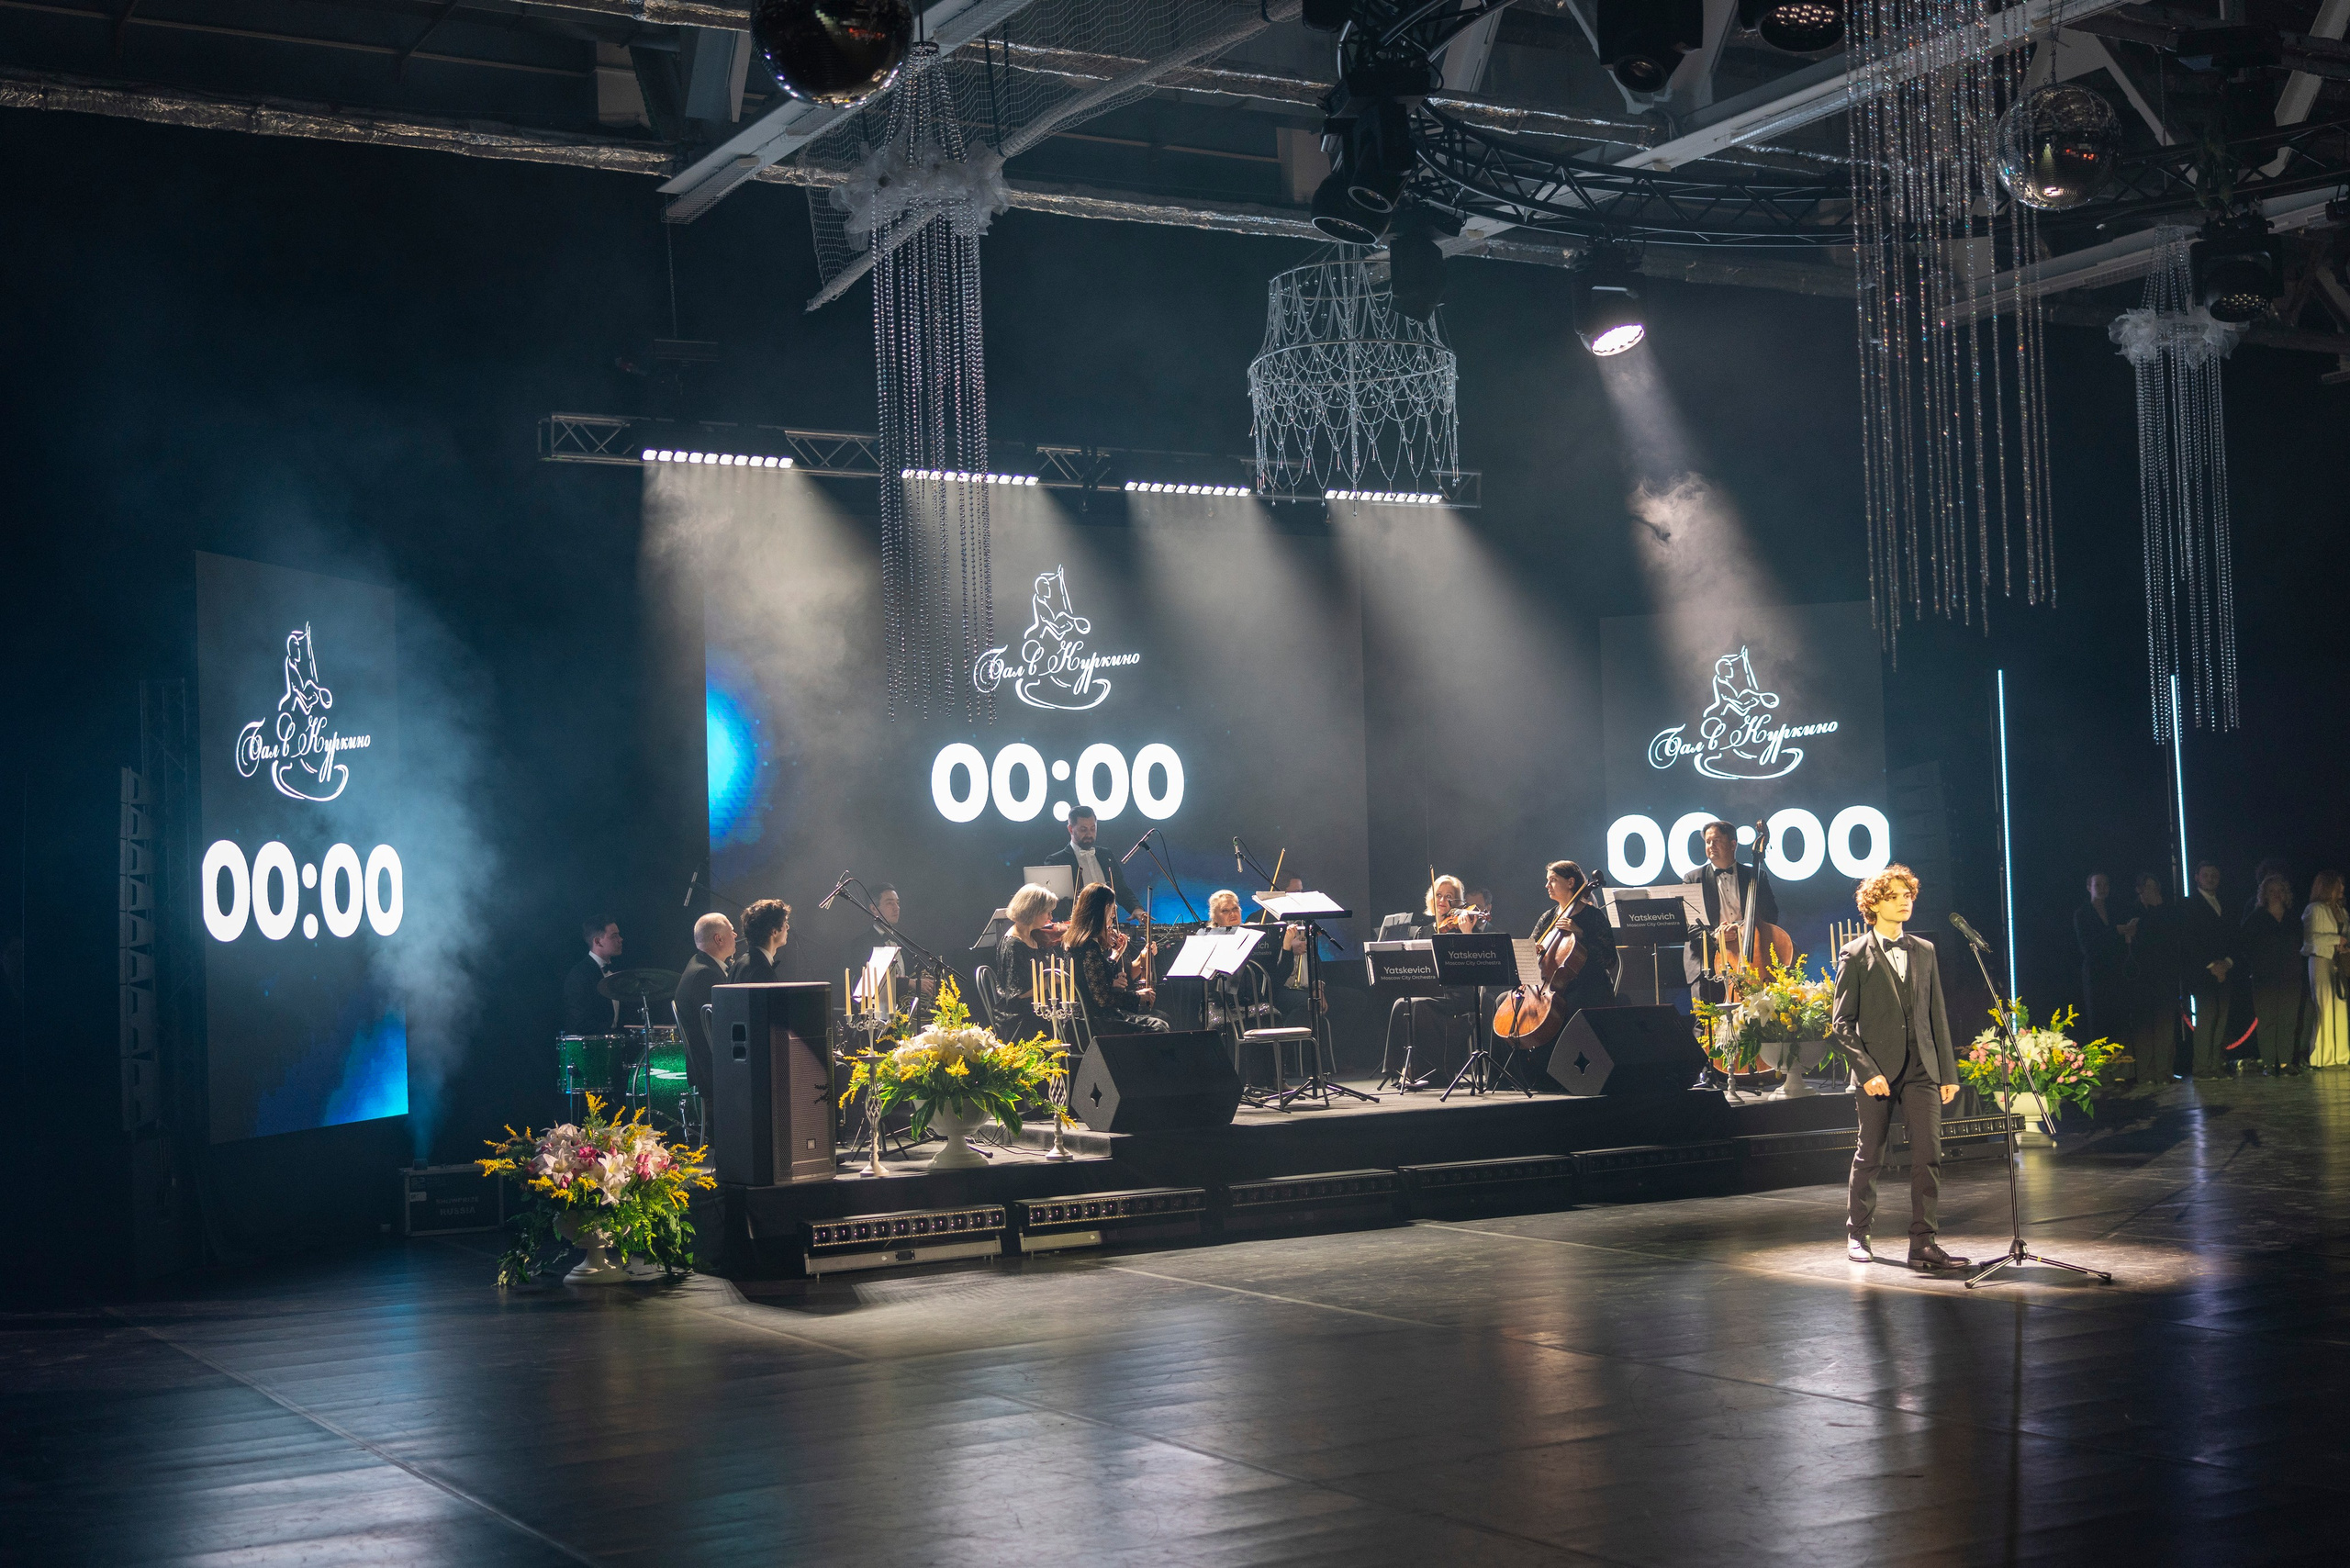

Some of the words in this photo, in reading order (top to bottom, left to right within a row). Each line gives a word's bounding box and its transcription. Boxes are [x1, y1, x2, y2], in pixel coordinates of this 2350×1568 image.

[973, 644, 1024, 693] Бал
[1038, 641, 1140, 695] Куркино
[236, 717, 280, 778] Бал
[291, 715, 371, 783] Куркино
[1648, 723, 1705, 769] Бал
[1719, 714, 1839, 766] Куркино
[931, 743, 1184, 823] 00:00
[202, 839, 404, 942] 00:00
[1628, 913, 1675, 922] Yatskevich
[1383, 966, 1431, 974] Yatskevich
[1448, 950, 1496, 959] Yatskevich
[440, 1206, 476, 1216] RUSSIA
